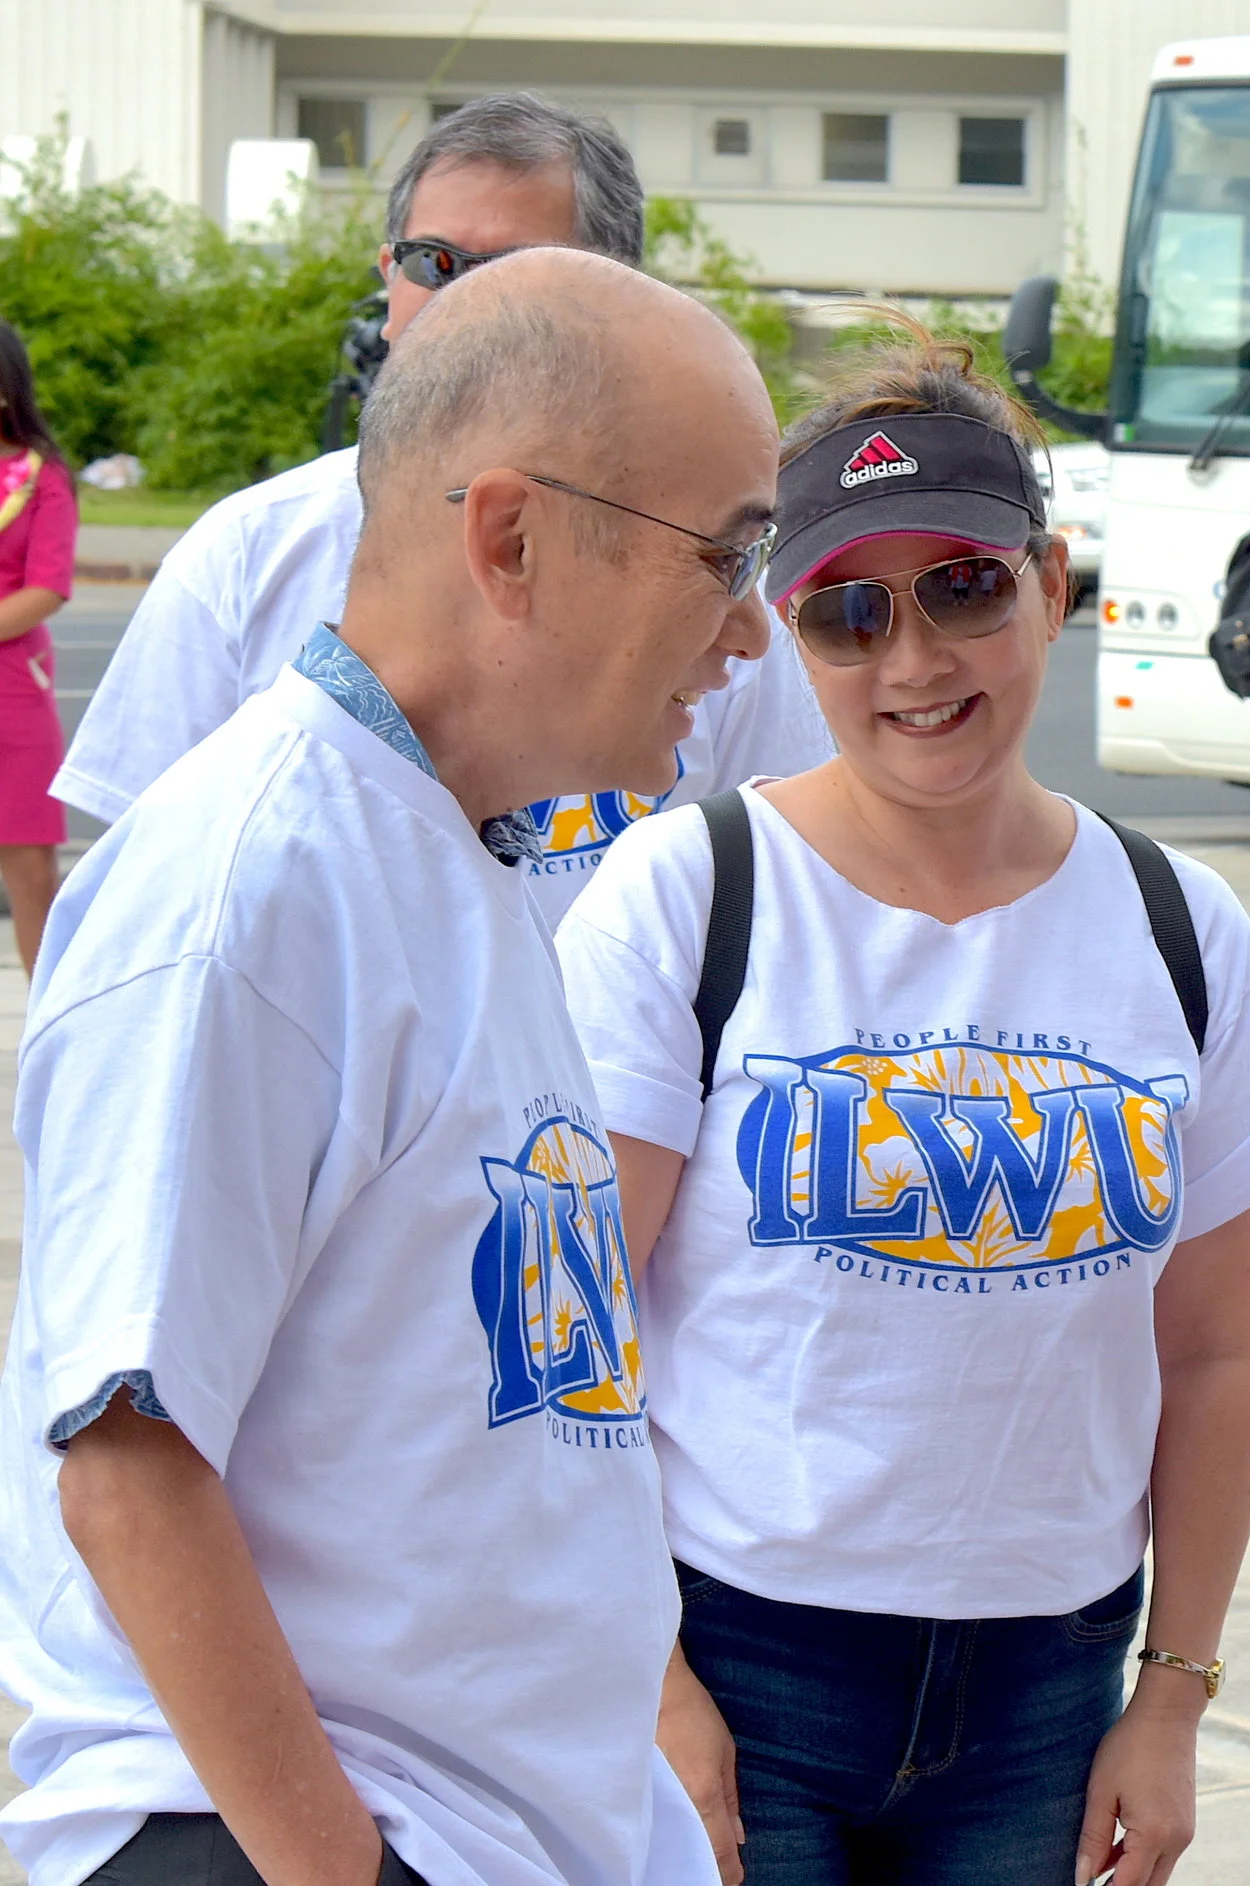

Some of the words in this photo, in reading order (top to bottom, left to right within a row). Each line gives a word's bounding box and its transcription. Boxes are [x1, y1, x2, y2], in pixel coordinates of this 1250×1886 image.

[844, 460, 913, 485] adidas
[528, 853, 604, 876] ACTIO
[854, 1025, 980, 1048] PEOPLE
[996, 1030, 1093, 1056] FIRST
[743, 1053, 1189, 1254] ILWU
[813, 1246, 991, 1294] POLITICAL
[1012, 1252, 1132, 1293] ACTION
[546, 1411, 645, 1449] POLITICAL
